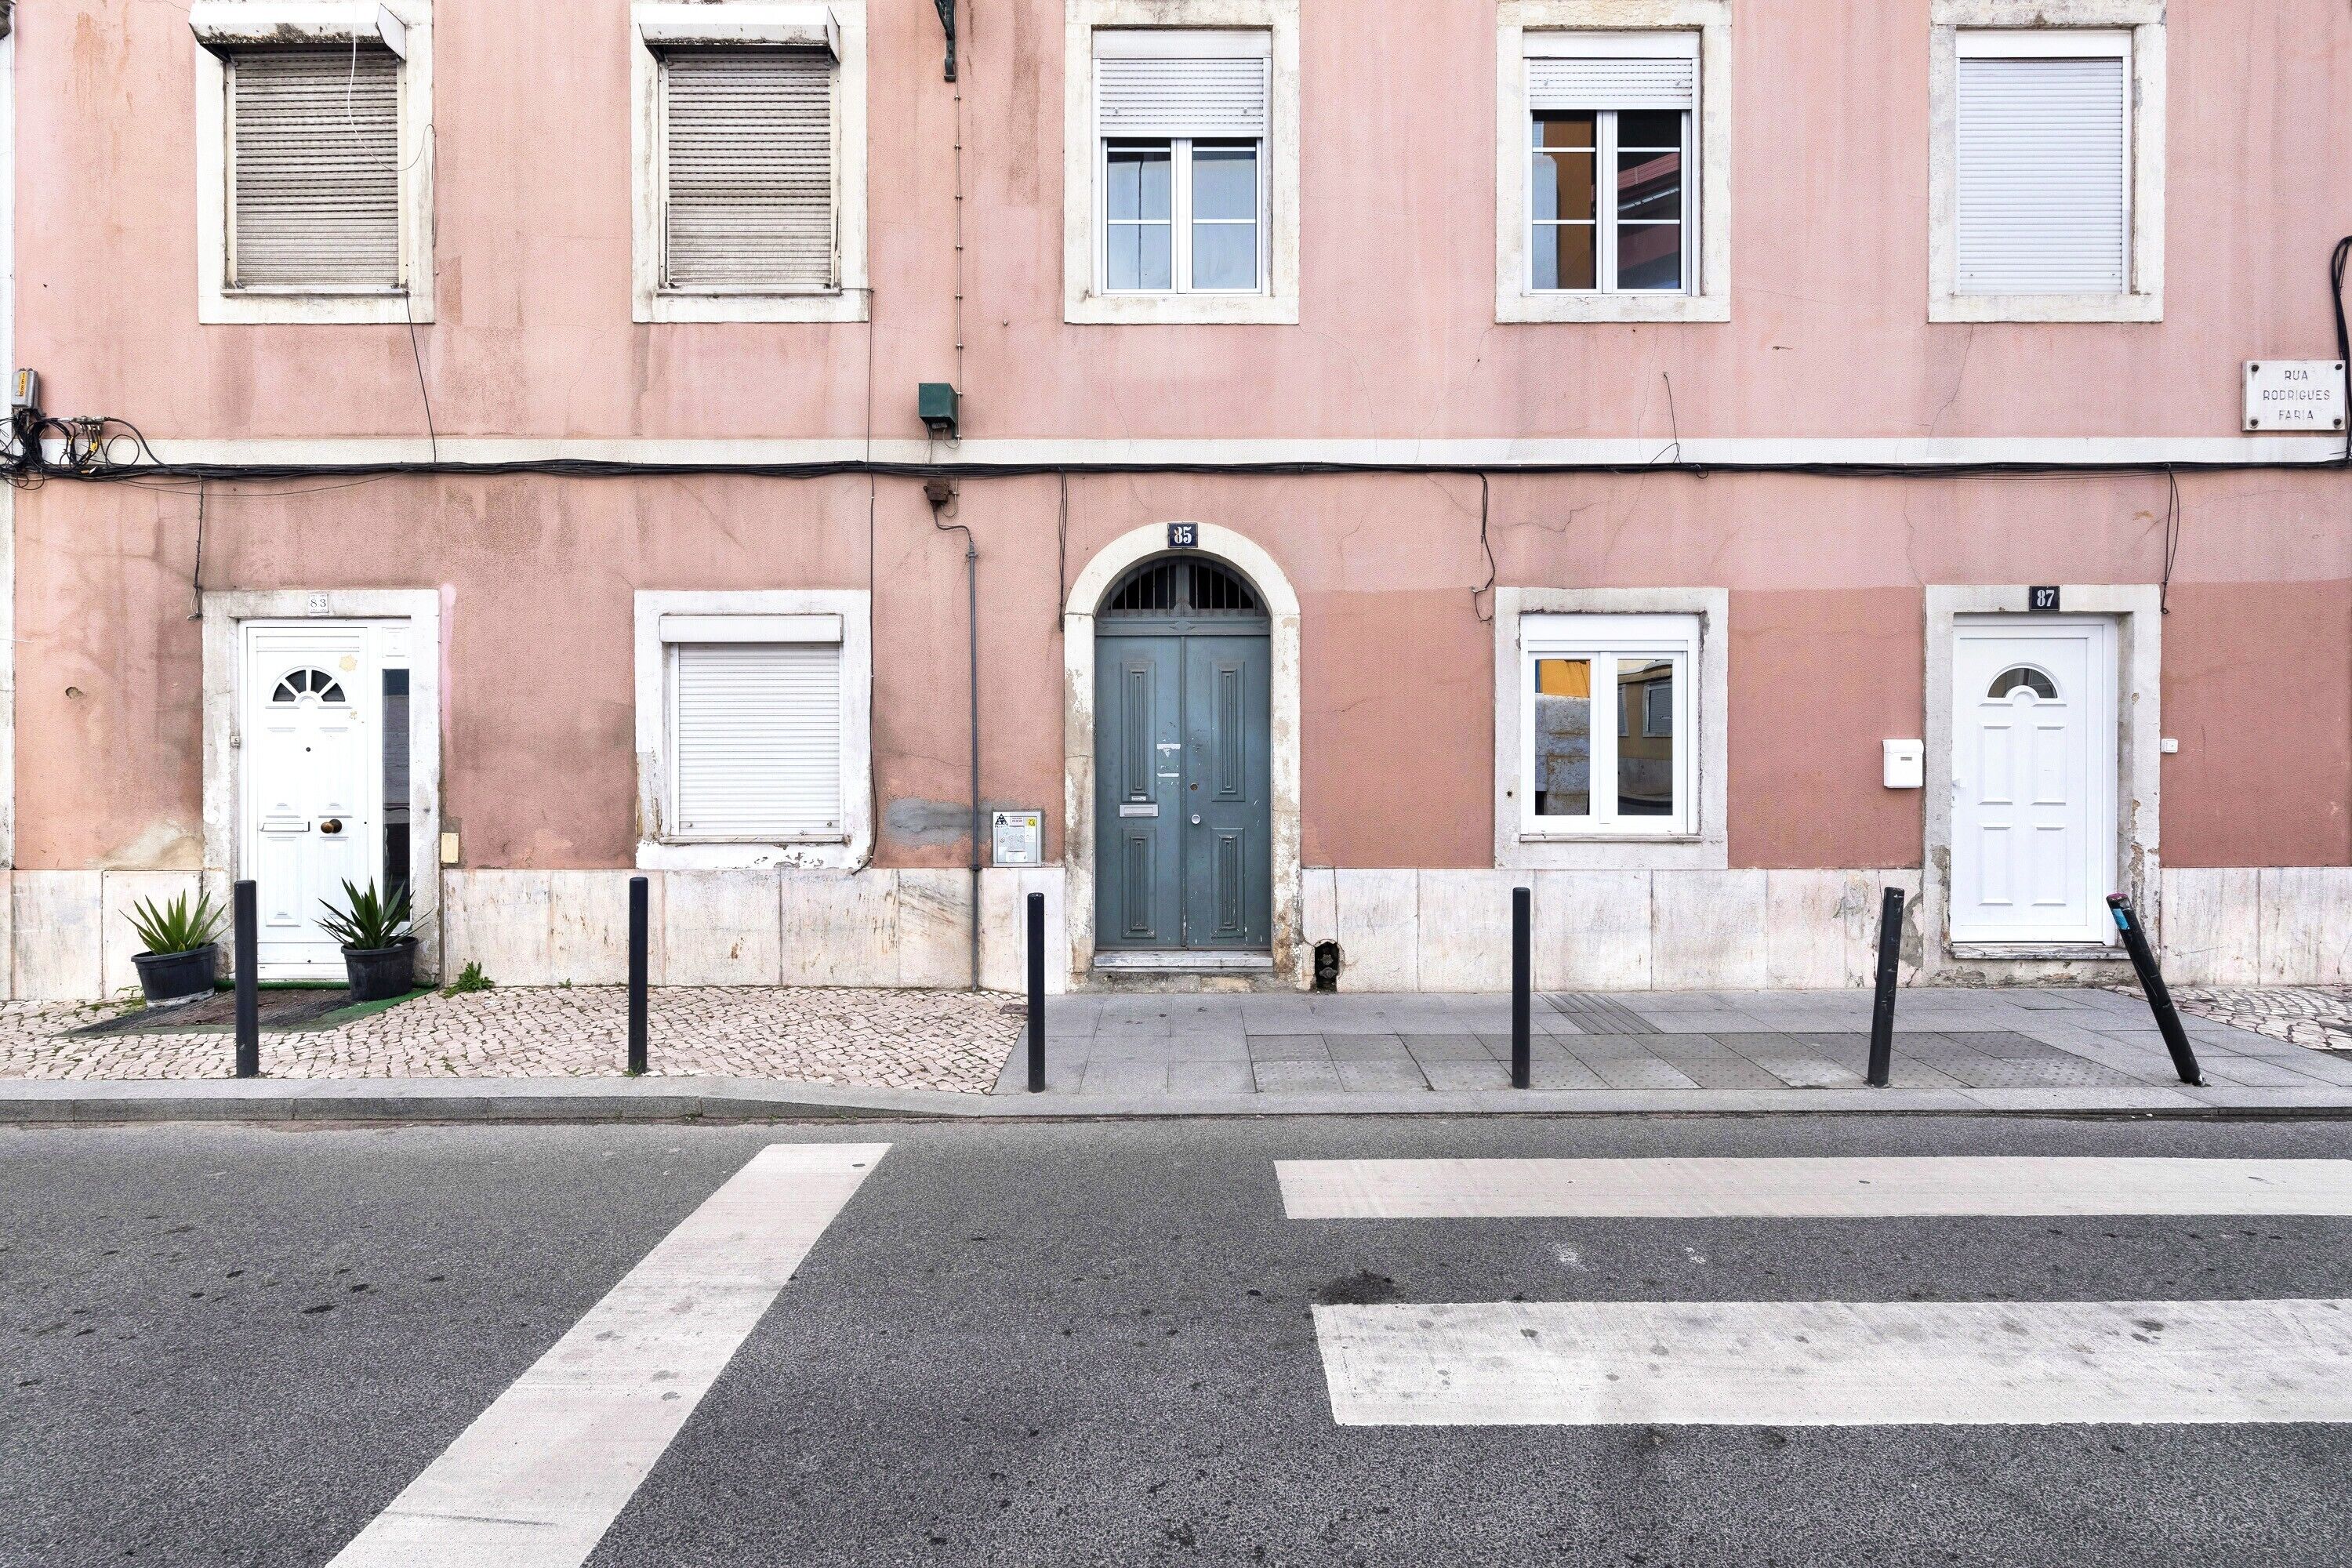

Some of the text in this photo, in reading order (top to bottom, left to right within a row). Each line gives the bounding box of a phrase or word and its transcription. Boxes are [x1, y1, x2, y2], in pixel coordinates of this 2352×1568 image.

[2285, 370, 2308, 380] RUA
[2263, 390, 2331, 401] RODRIGUES
[2278, 409, 2314, 420] FARIA
[1174, 526, 1192, 544] 85
[310, 598, 326, 608] 83
[2037, 590, 2055, 607] 87
